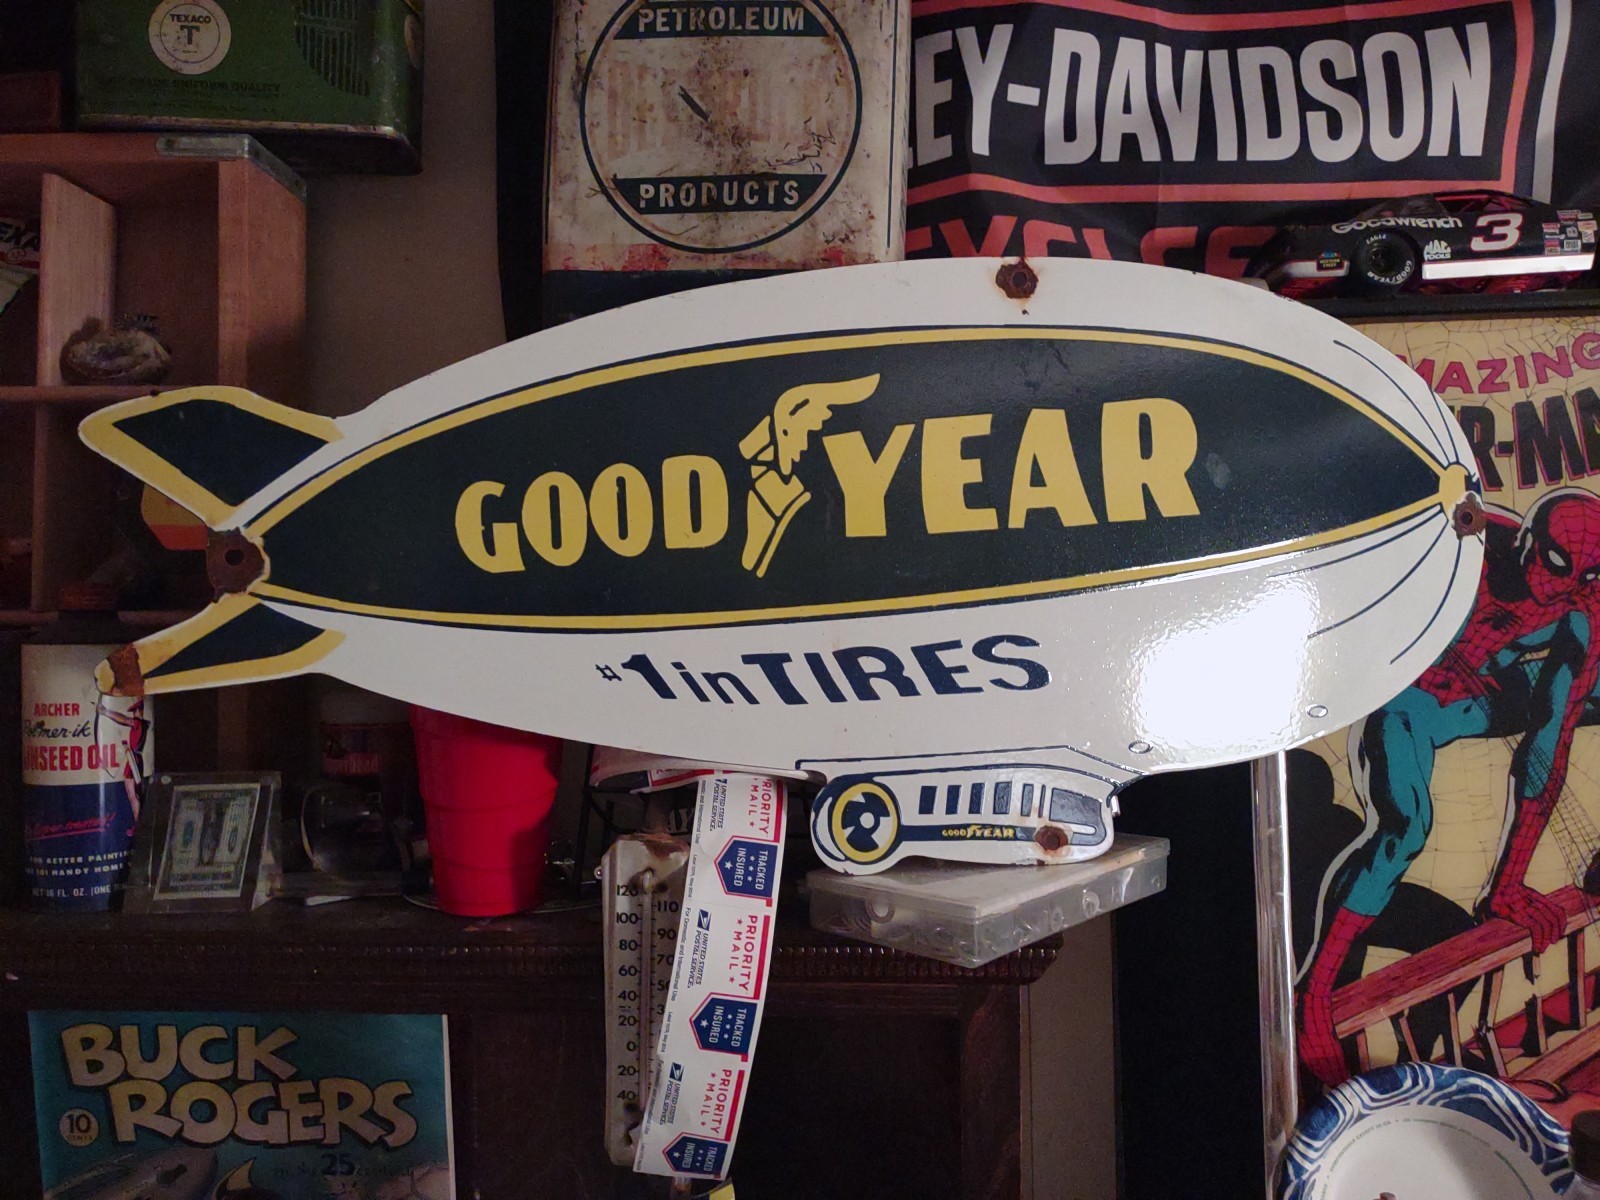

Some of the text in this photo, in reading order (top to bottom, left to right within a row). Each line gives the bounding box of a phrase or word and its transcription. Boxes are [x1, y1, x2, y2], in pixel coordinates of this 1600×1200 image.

[169, 13, 212, 25] TEXACO
[638, 6, 805, 33] PETROLEUM
[908, 22, 1492, 168] EY-DAVIDSON
[639, 180, 801, 209] PRODUCTS
[1471, 211, 1523, 252] 3
[741, 634, 1053, 705] TIRES
[33, 702, 80, 717] ARCHER
[87, 743, 120, 770] OIL
[719, 785, 727, 806] UNITED
[748, 784, 759, 816] MAIL
[942, 825, 1015, 839] GOODYEAR
[46, 856, 83, 865] BETTER
[52, 867, 89, 876] HANDY
[733, 847, 746, 887] INSURED
[755, 850, 768, 890] TRACKED
[657, 900, 679, 913] 110
[616, 912, 638, 924] 100
[619, 939, 638, 951] 80
[657, 928, 677, 940] 90
[693, 930, 701, 956] POSTAL
[657, 954, 674, 966] 70
[696, 933, 709, 985] UNITED STATES
[729, 931, 743, 970] MAIL
[738, 914, 758, 991] PRIORITY
[618, 965, 637, 976] 60
[618, 990, 637, 1001] 40
[618, 1015, 637, 1026] 20
[657, 1004, 665, 1015] 3
[709, 1005, 724, 1043] INSURED
[731, 1008, 747, 1047] TRACKED
[61, 1022, 299, 1088] BUCK
[626, 1041, 636, 1051] 0
[618, 1065, 636, 1076] 20
[617, 1090, 636, 1101] 40
[664, 1080, 673, 1102] POSTAL
[672, 1083, 681, 1105] UNITED
[701, 1082, 716, 1116] MAIL
[711, 1068, 732, 1134] PRIORITY
[108, 1076, 418, 1149] ROGERS
[66, 1114, 91, 1134] 10
[703, 1146, 718, 1172] TRACKED
